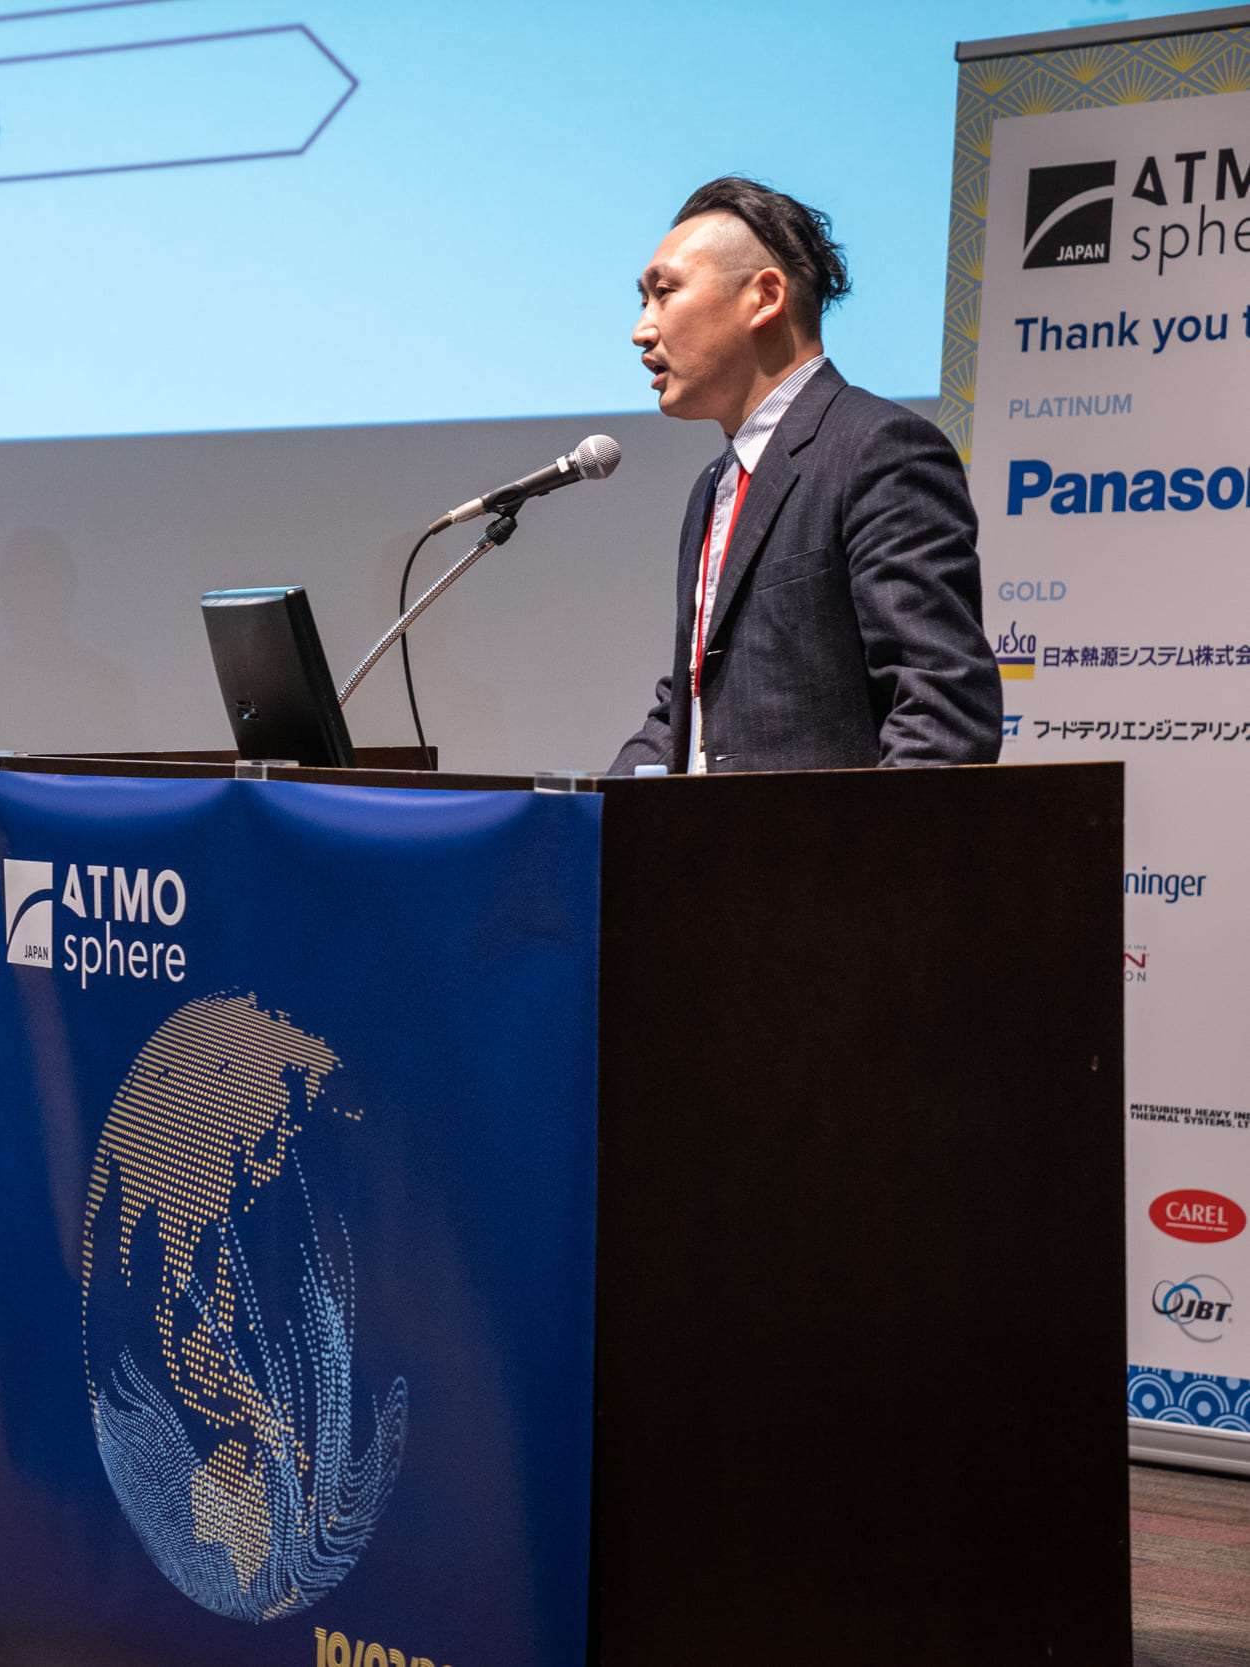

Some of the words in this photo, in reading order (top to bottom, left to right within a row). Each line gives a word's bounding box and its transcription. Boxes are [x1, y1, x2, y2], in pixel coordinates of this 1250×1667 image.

[1056, 243, 1105, 262] JAPAN
[1015, 311, 1140, 352] Thank
[1152, 313, 1228, 354] you
[1009, 394, 1133, 419] PLATINUM
[1007, 459, 1250, 516] Panaso
[998, 580, 1067, 601] GOLD
[995, 621, 1036, 654] JESCO
[62, 863, 186, 926] ATMO
[24, 944, 49, 961] JAPAN
[63, 920, 186, 990] sphere
[1130, 1103, 1191, 1115] MITSUBISHI
[1195, 1108, 1230, 1118] HEAVY
[1130, 1112, 1179, 1123] THERMAL
[1166, 1201, 1228, 1225] CAREL
[1180, 1299, 1232, 1322] JBT
